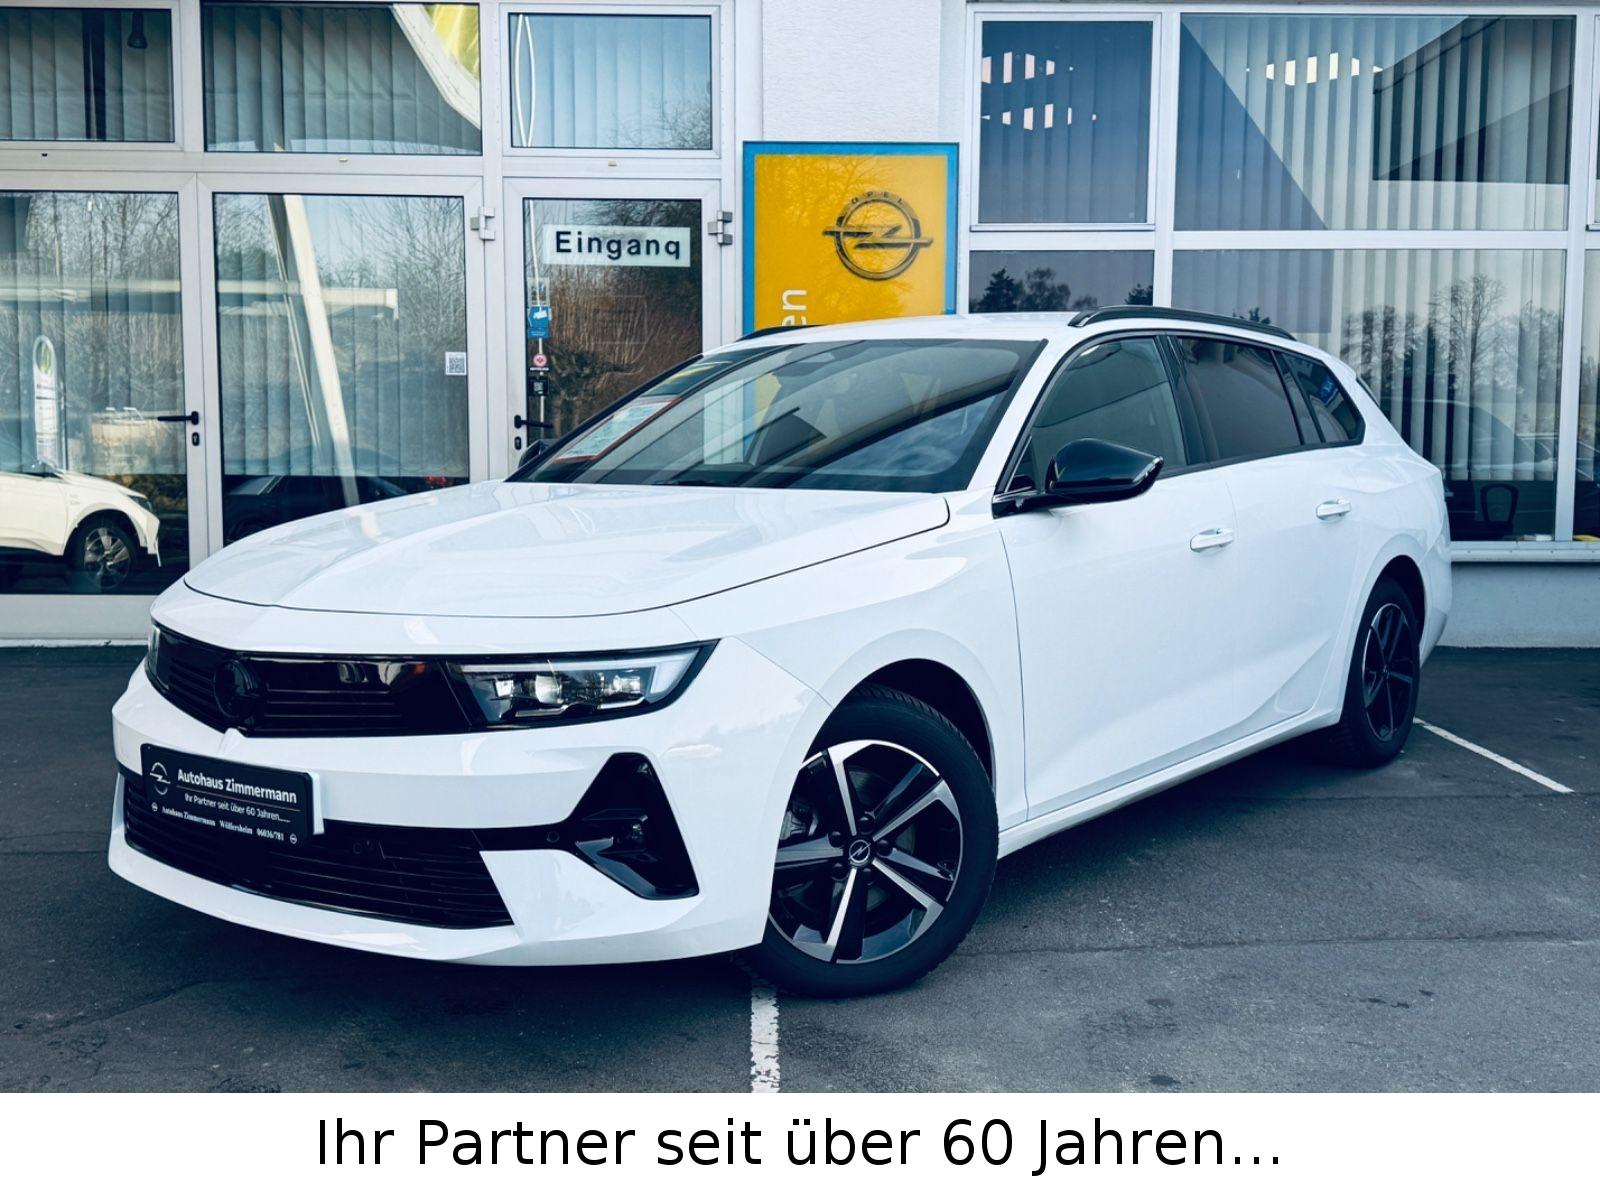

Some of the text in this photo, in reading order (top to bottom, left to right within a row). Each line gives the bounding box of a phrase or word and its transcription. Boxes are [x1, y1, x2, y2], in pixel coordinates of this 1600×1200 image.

[850, 190, 904, 205] OPEL
[177, 768, 297, 804] Autohaus Zimmermann
[184, 793, 194, 802] Ihr
[193, 795, 216, 808] Partner
[217, 800, 230, 811] seit
[230, 802, 245, 814] über
[245, 806, 256, 817] 60
[183, 811, 216, 827] Zimmermann
